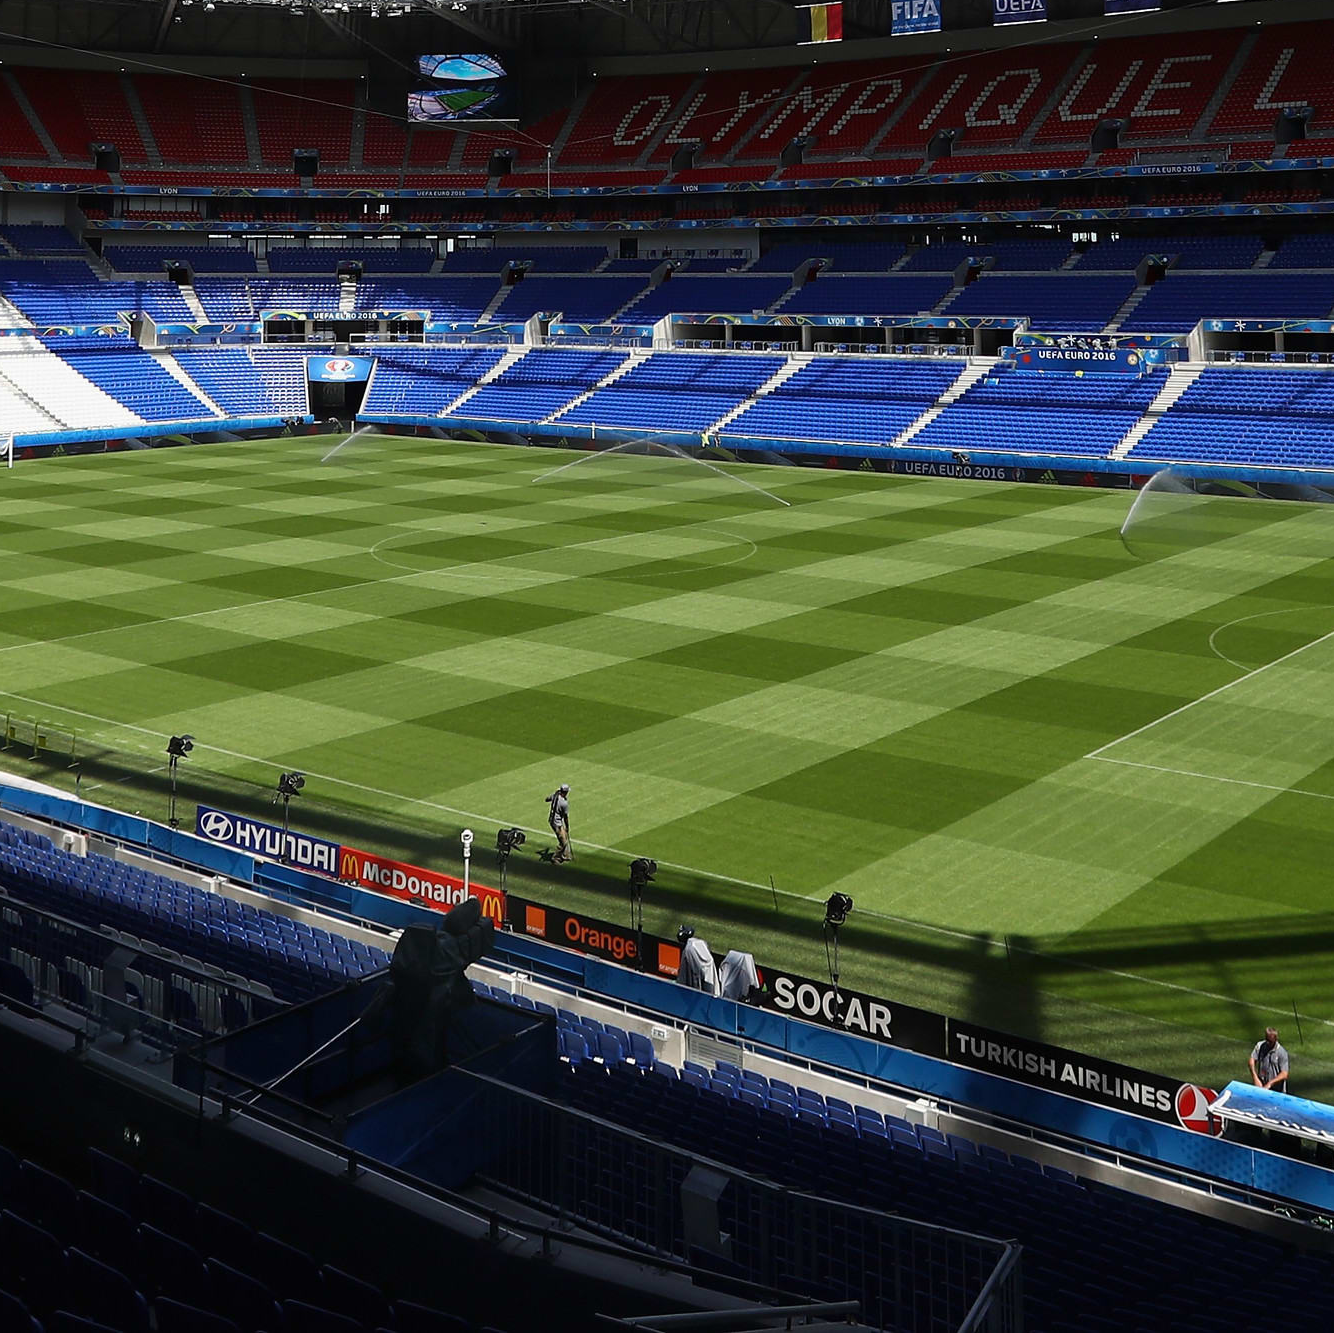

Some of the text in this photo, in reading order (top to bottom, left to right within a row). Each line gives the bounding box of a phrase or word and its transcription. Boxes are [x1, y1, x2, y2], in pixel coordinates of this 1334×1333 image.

[613, 54, 1213, 146] OLYMPIQUE
[1141, 165, 1202, 174] UEFA EURO 2016
[827, 317, 846, 325] LYON
[1038, 350, 1116, 361] UEFA EURO 2016
[904, 462, 937, 476] UEFA
[974, 467, 1005, 479] 2016
[235, 820, 336, 872] HYUNDAI
[564, 917, 638, 960] Orange
[773, 976, 892, 1039] SOCAR
[956, 1032, 1172, 1112] TURKISH AIRLINES
